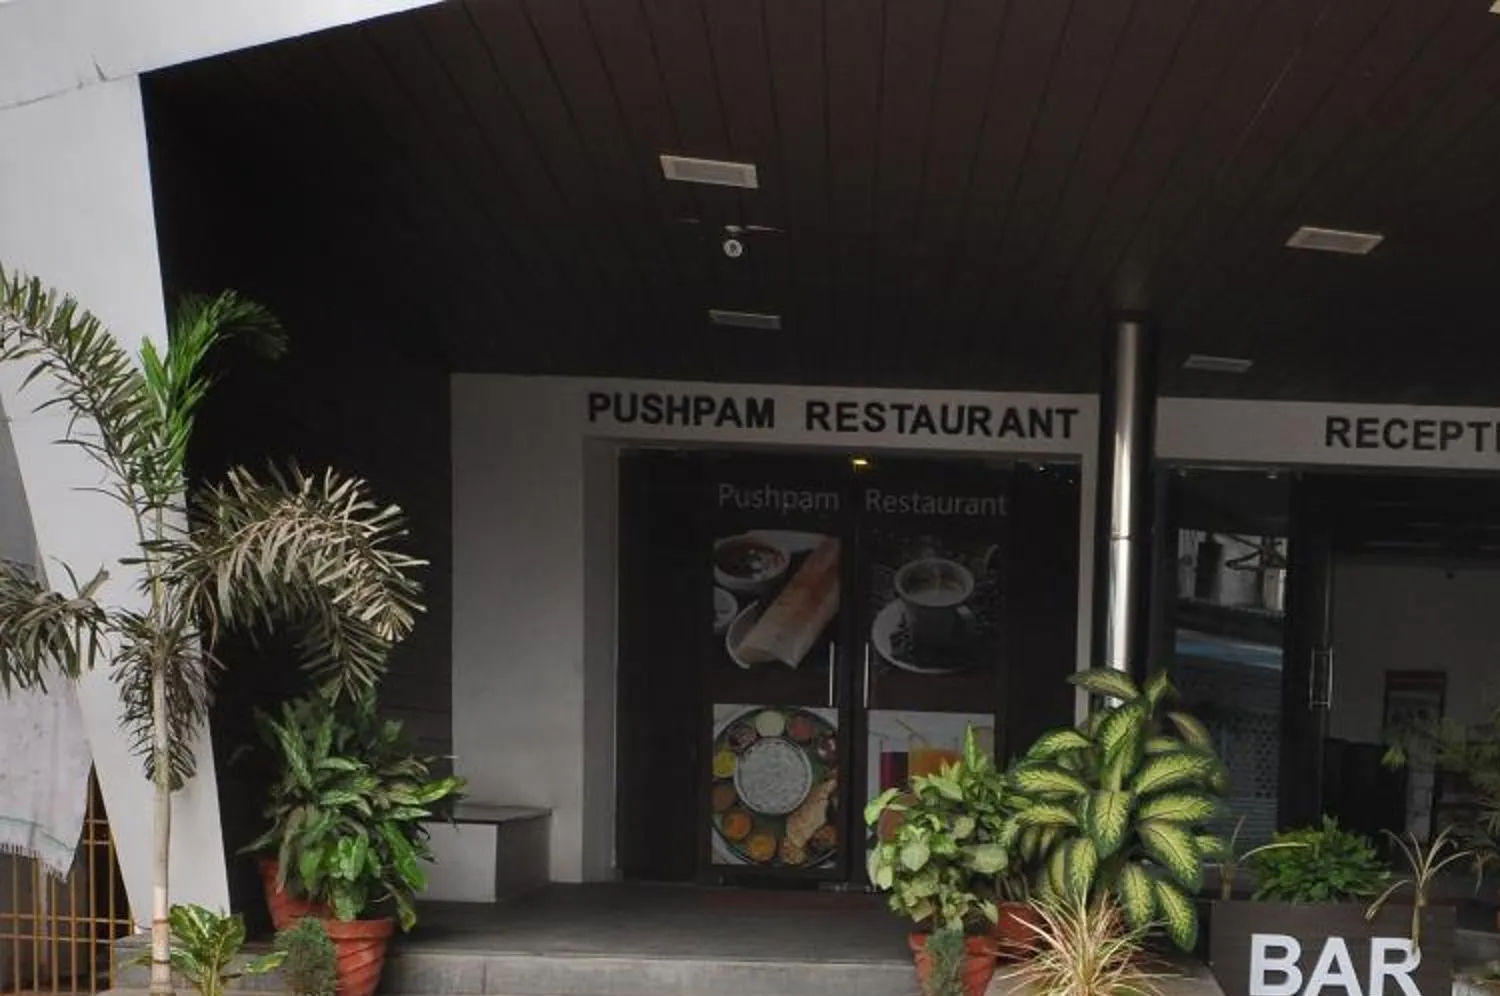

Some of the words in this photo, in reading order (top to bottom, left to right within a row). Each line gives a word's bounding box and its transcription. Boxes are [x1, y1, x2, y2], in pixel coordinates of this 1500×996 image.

[588, 392, 775, 429] PUSHPAM
[805, 402, 1079, 439] RESTAURANT
[718, 483, 840, 516] Pushpam
[865, 489, 1008, 517] Restaurant
